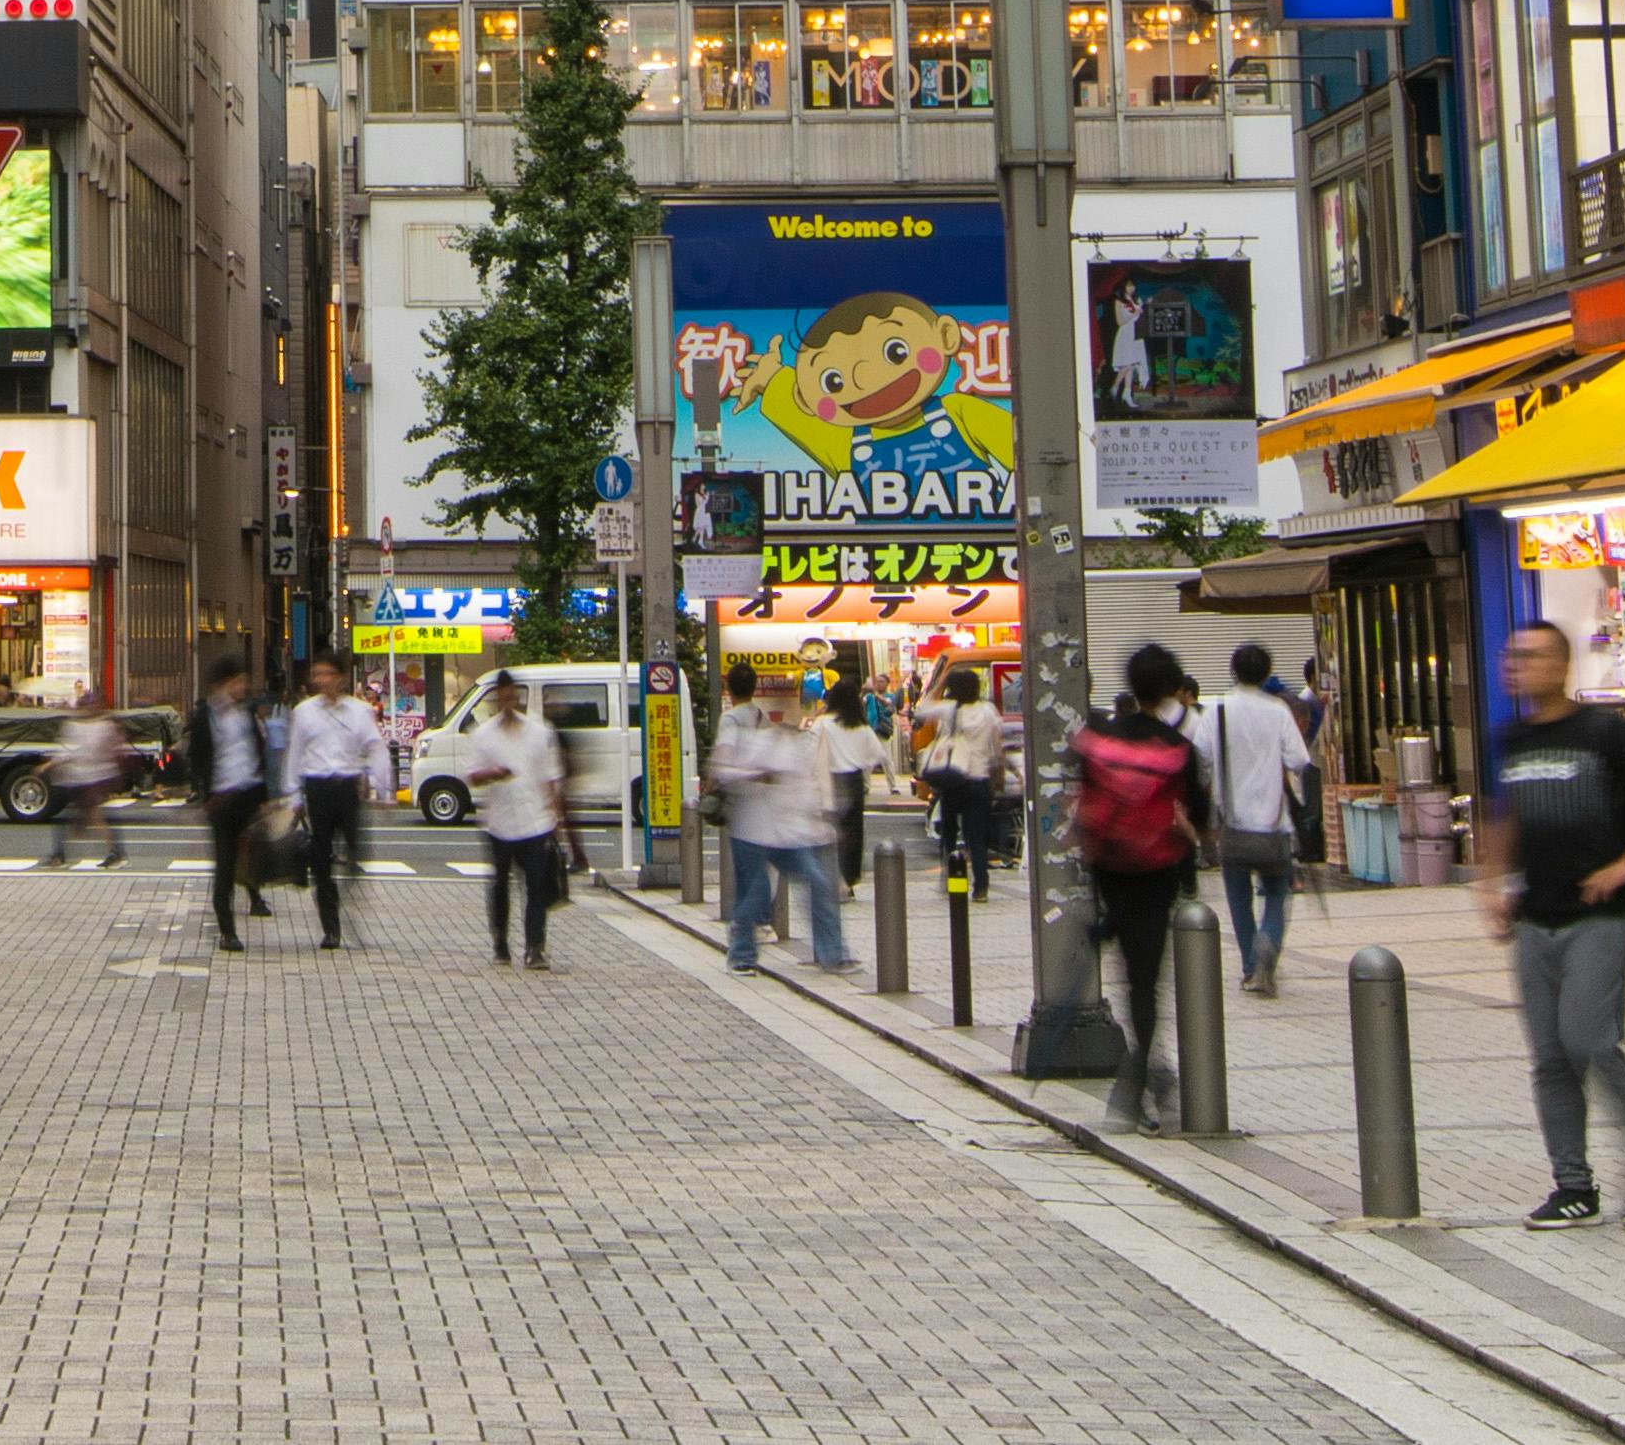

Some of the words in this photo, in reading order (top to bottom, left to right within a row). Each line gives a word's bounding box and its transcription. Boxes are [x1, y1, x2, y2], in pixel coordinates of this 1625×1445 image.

[767, 214, 898, 239] Welcome
[901, 215, 933, 238] to
[1101, 441, 1161, 454] WONDER
[1167, 440, 1220, 453] QUEST
[1229, 440, 1249, 451] EP
[1180, 455, 1207, 466] SALE
[726, 652, 800, 666] ONODEN
